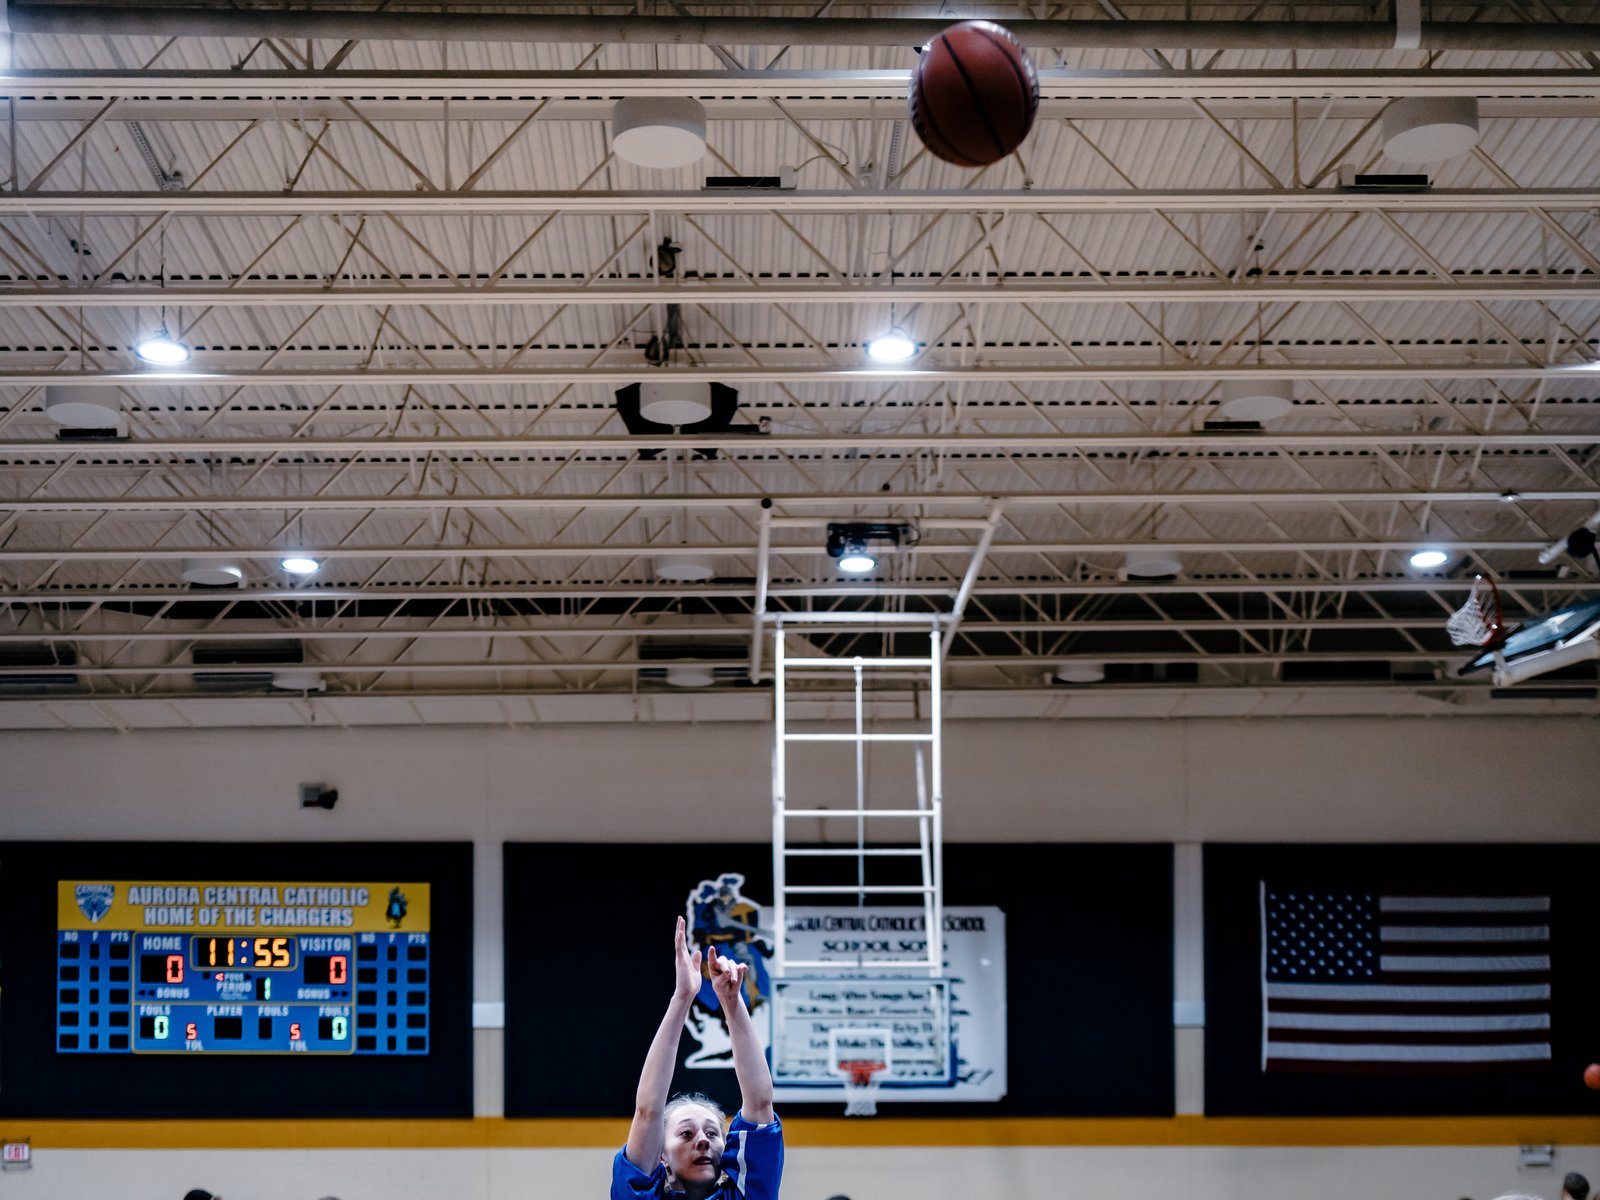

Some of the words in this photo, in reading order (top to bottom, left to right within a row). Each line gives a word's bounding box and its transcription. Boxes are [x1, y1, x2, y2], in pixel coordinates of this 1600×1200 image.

[128, 886, 200, 905] AURORA
[204, 887, 280, 906] CENTRAL
[284, 887, 369, 906] CATHOLIC
[144, 907, 195, 926] HOME
[198, 907, 220, 926] OF
[223, 907, 256, 926] THE
[259, 908, 353, 927] CHARGERS
[64, 931, 79, 942] NO
[110, 931, 129, 942] PTS
[408, 933, 427, 944] PTS
[143, 936, 182, 951] HOME
[300, 937, 351, 952] VISITOR
[823, 940, 889, 953] SCHOOL
[209, 938, 290, 967] 11:55
[166, 955, 184, 984] 0
[329, 956, 347, 985] 0
[157, 987, 190, 999] BONUS
[216, 981, 252, 993] PERIOD
[264, 977, 271, 1000] 1
[297, 987, 330, 1000] BONUS
[140, 1004, 171, 1016] FOULS
[206, 1004, 243, 1017] PLAYER
[258, 1005, 289, 1017] FOULS
[319, 1005, 350, 1017] FOULS
[154, 1015, 169, 1040] 0
[332, 1016, 348, 1041] 0
[185, 1040, 203, 1052] TOL
[289, 1040, 308, 1052] TOL
